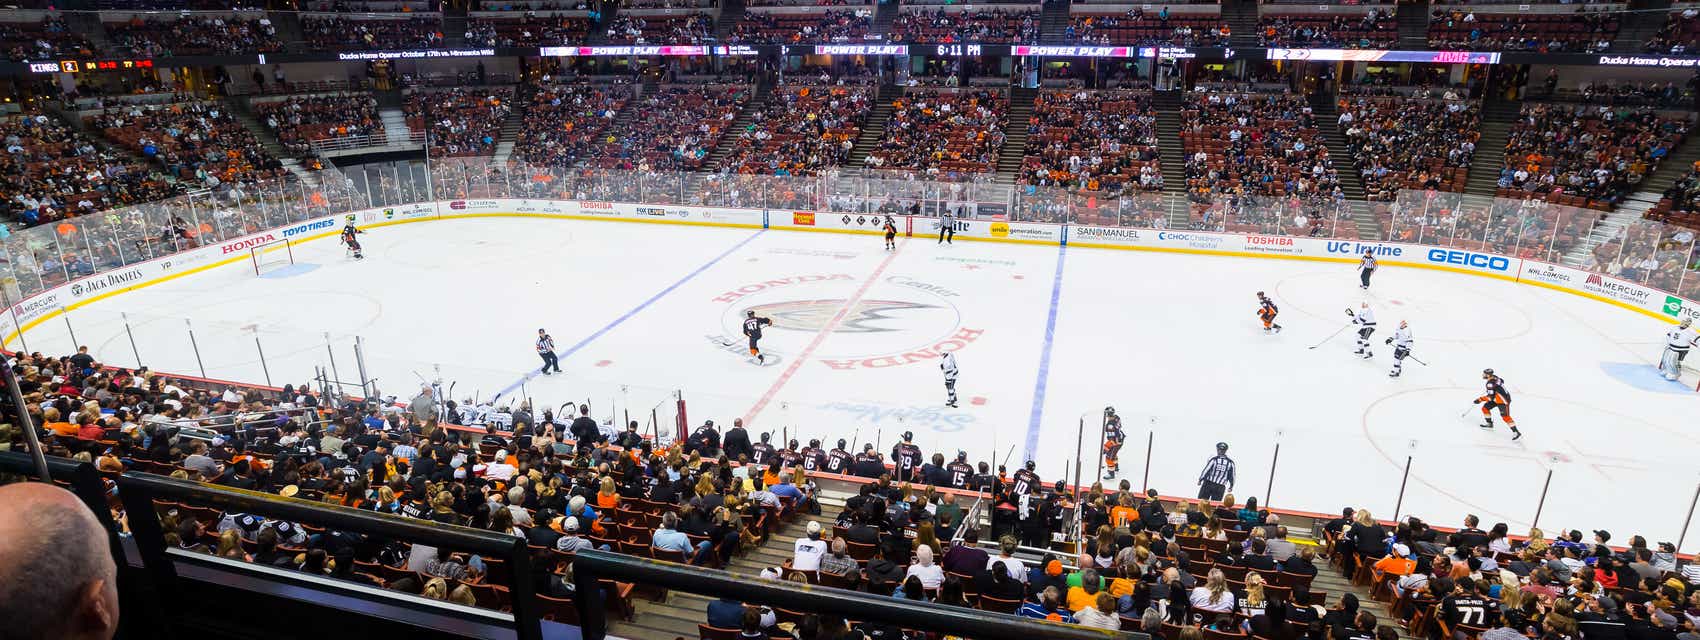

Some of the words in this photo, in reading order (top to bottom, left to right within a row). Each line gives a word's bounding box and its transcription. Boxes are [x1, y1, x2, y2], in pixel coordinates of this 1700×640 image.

[592, 47, 630, 55] POWER
[633, 46, 660, 54] PLAY
[823, 46, 864, 54] POWER
[868, 46, 899, 54] PLAY
[937, 45, 962, 56] 6:11
[967, 45, 981, 56] PM
[1029, 47, 1076, 56] POWER
[1079, 47, 1113, 56] PLAY
[30, 63, 59, 73] KINGS
[1599, 56, 1628, 65] Ducks
[1629, 57, 1658, 66] Home
[1659, 57, 1697, 67] Opener
[580, 201, 613, 209] TOSHIBA
[282, 226, 307, 238] TOYO
[308, 219, 335, 232] TIRES
[1077, 227, 1096, 236] SAN
[1103, 228, 1140, 239] MANUEL
[221, 233, 276, 255] HONDA
[1167, 233, 1189, 241] CHOC
[1246, 236, 1293, 246] TOSHIBA
[1327, 242, 1350, 254] UC
[1354, 243, 1402, 257] Irvine
[1427, 248, 1510, 271] GEICO
[86, 279, 108, 293] JACK
[108, 268, 143, 287] DANIEL'S
[711, 273, 854, 304] HONDA
[1583, 284, 1617, 298] INSURANCE
[1603, 282, 1650, 300] MERCURY
[24, 294, 57, 312] MERCURY
[753, 450, 762, 464] 4
[804, 456, 816, 470] 16
[827, 456, 840, 470] 18
[952, 471, 966, 486] 15
[1013, 480, 1028, 495] 10
[1457, 606, 1485, 625] 77
